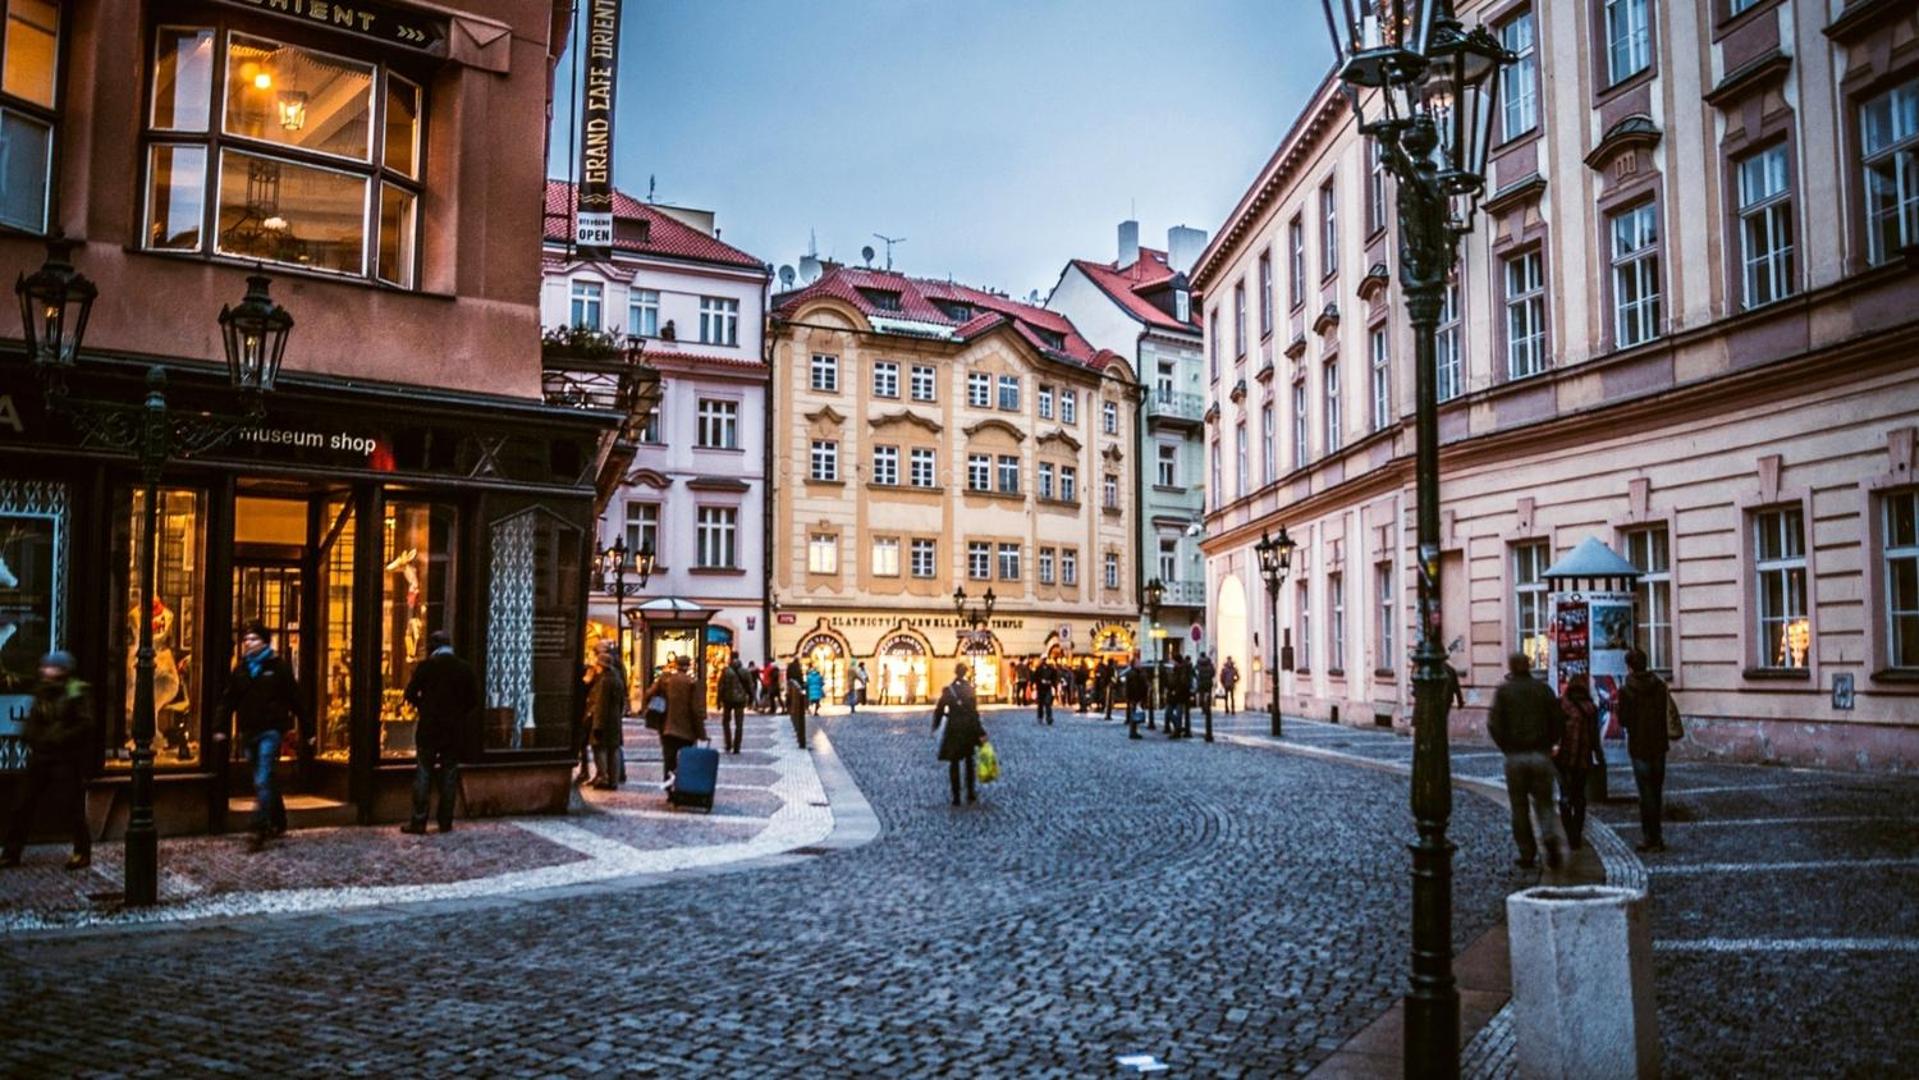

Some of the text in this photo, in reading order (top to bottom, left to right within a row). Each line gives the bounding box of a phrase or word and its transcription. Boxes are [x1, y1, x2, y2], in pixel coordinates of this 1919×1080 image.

[246, 0, 375, 31] RIENT
[585, 0, 617, 182] GRAND CAFE ORIENT
[579, 229, 610, 241] OPEN
[240, 427, 376, 456] museum shop
